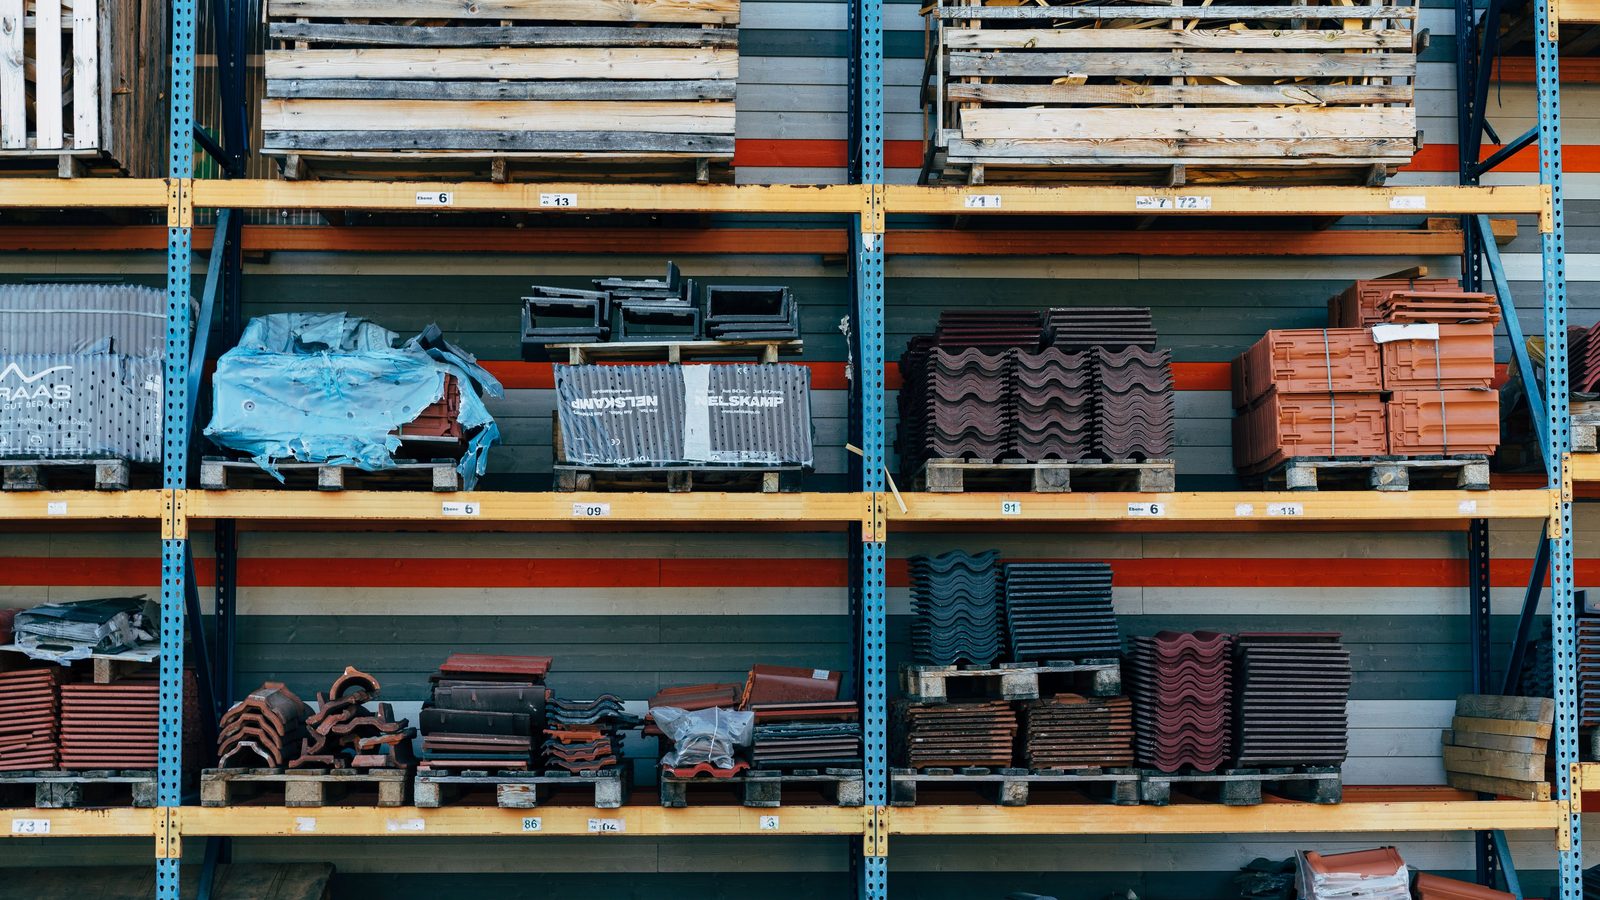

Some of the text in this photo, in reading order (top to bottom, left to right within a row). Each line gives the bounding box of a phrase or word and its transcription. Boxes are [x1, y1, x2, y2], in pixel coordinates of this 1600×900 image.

[438, 192, 448, 203] 6
[554, 197, 569, 206] 13
[1178, 197, 1197, 208] 72
[1159, 198, 1167, 208] 7
[3, 402, 23, 410] GUT
[571, 395, 659, 410] NELSKAMP
[464, 504, 474, 514] 6
[586, 506, 602, 516] 09
[1003, 503, 1016, 513] 91
[1149, 504, 1159, 514] 6
[16, 821, 35, 832] 73
[524, 819, 538, 829] 86
